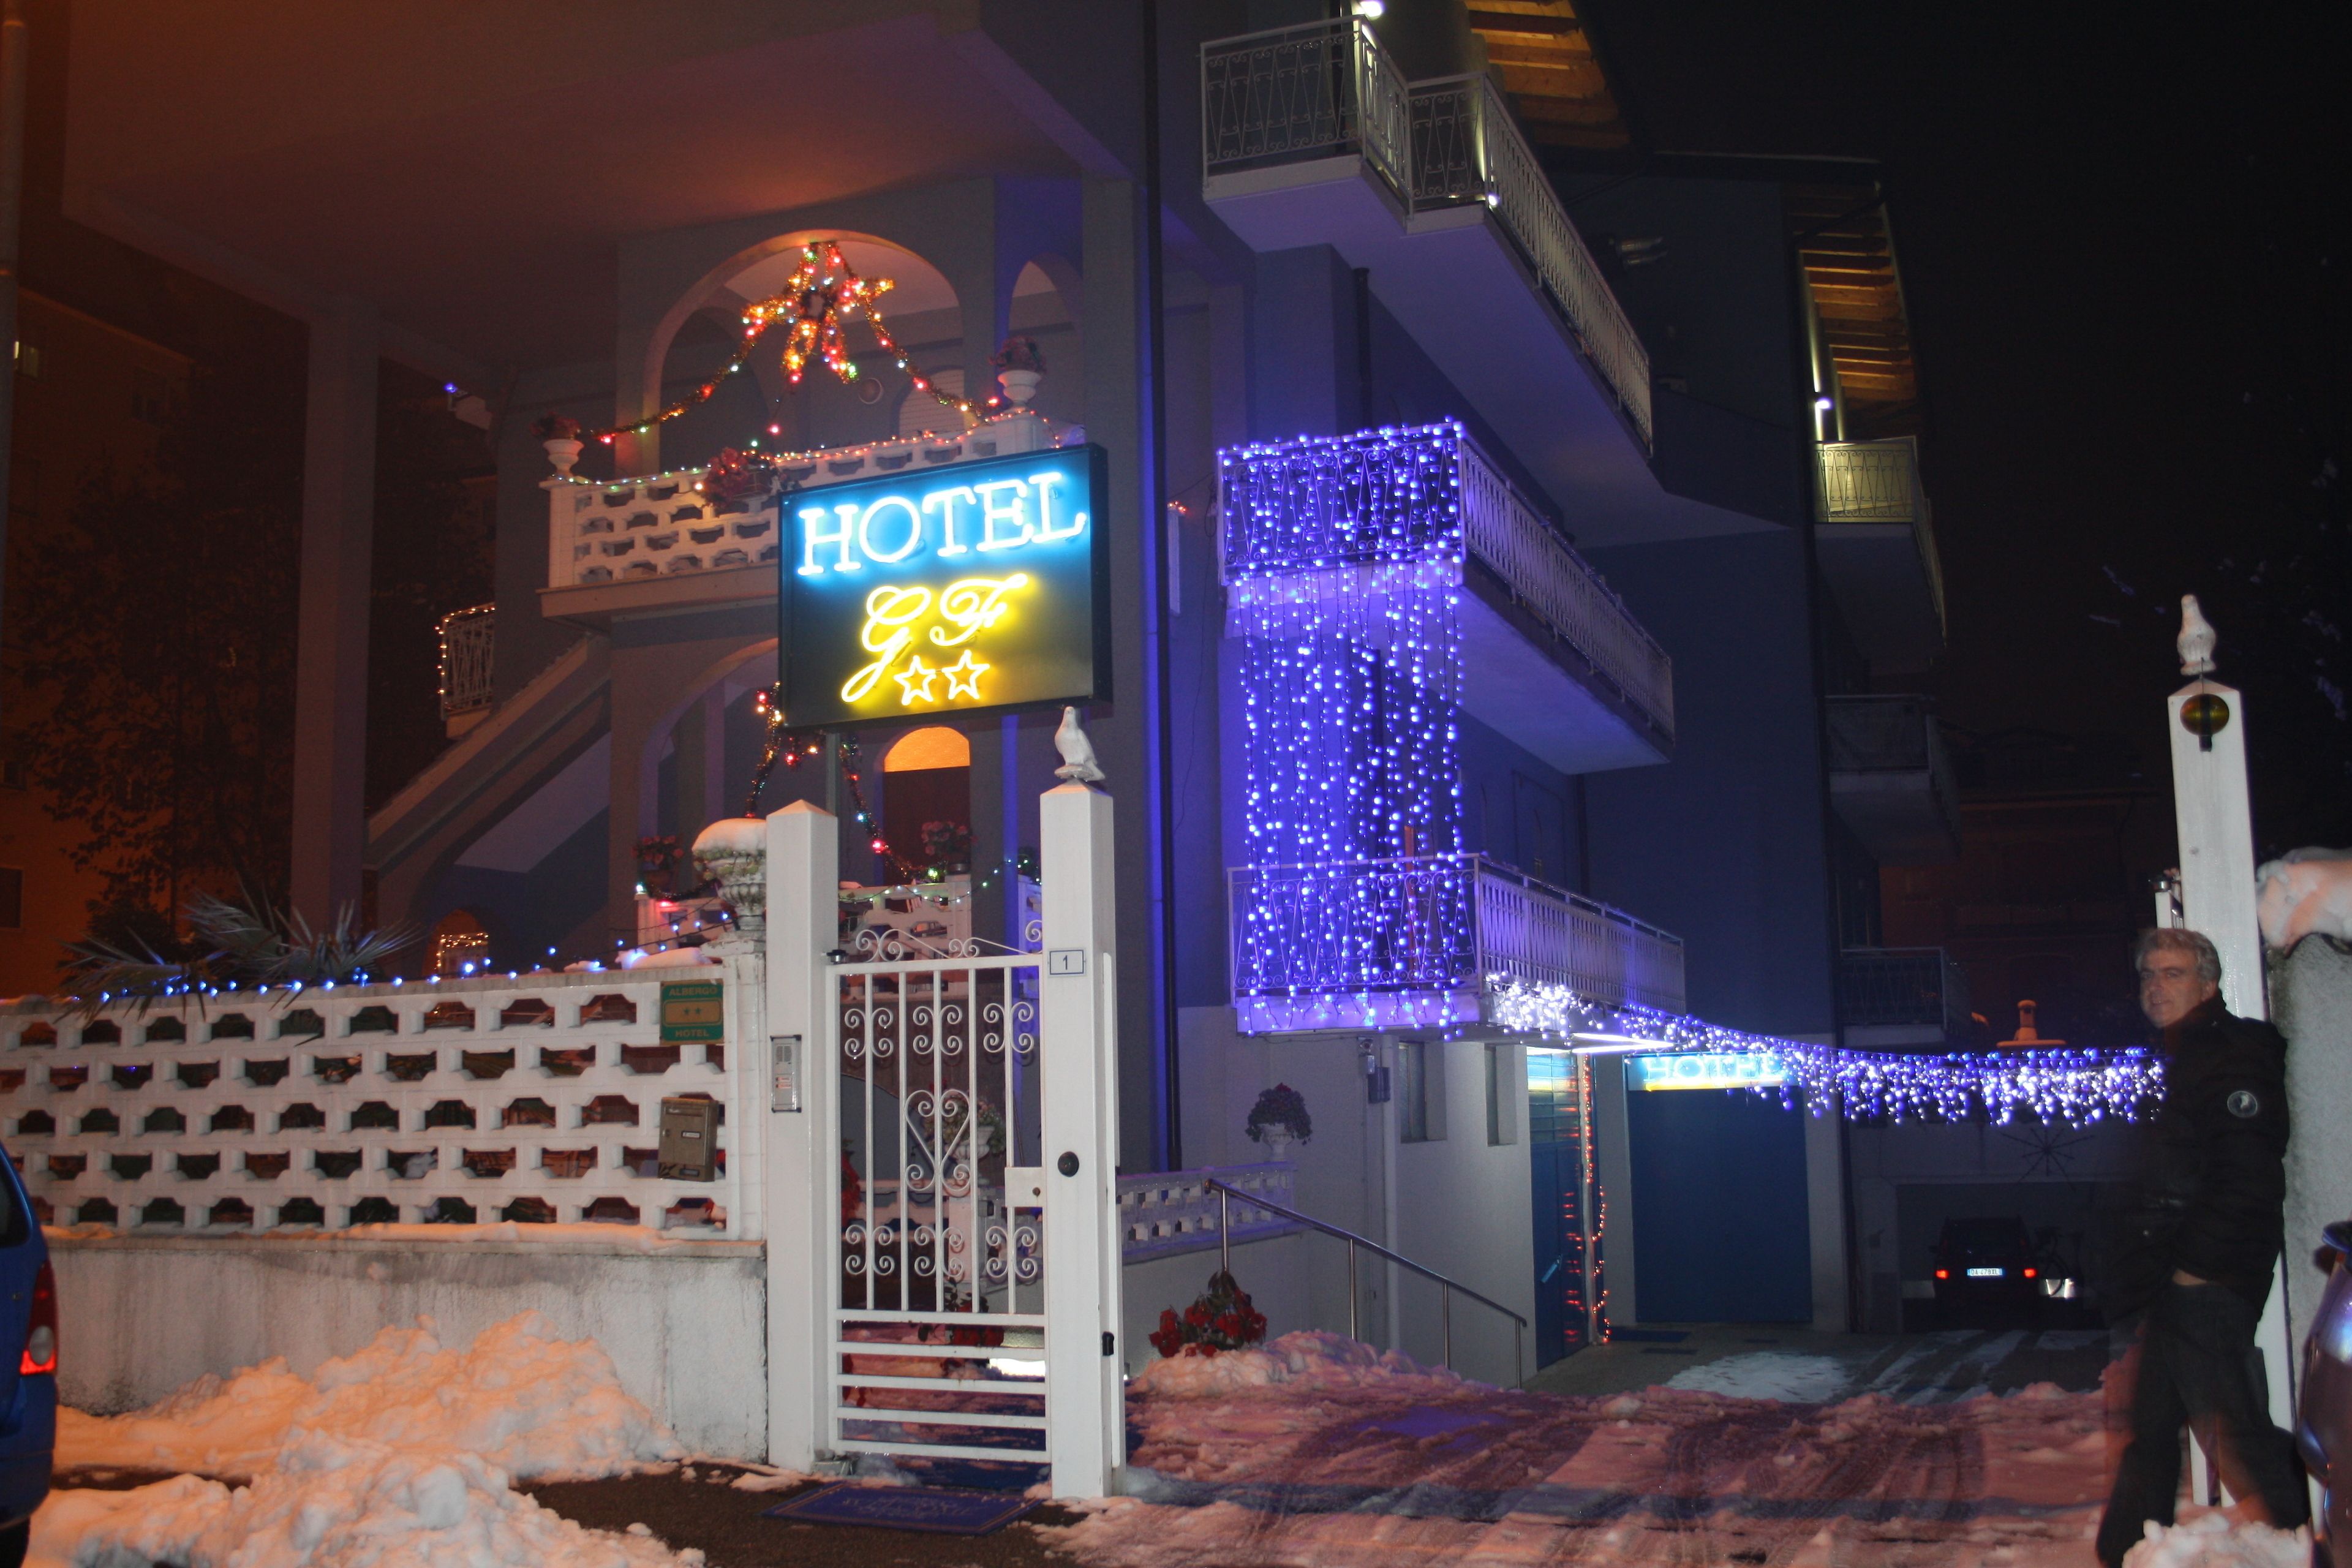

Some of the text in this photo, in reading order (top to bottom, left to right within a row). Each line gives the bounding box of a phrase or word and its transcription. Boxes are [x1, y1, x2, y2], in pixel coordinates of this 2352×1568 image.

[797, 471, 1087, 576] HOTEL
[1063, 955, 1068, 971] 1
[669, 987, 718, 996] ALBERGO
